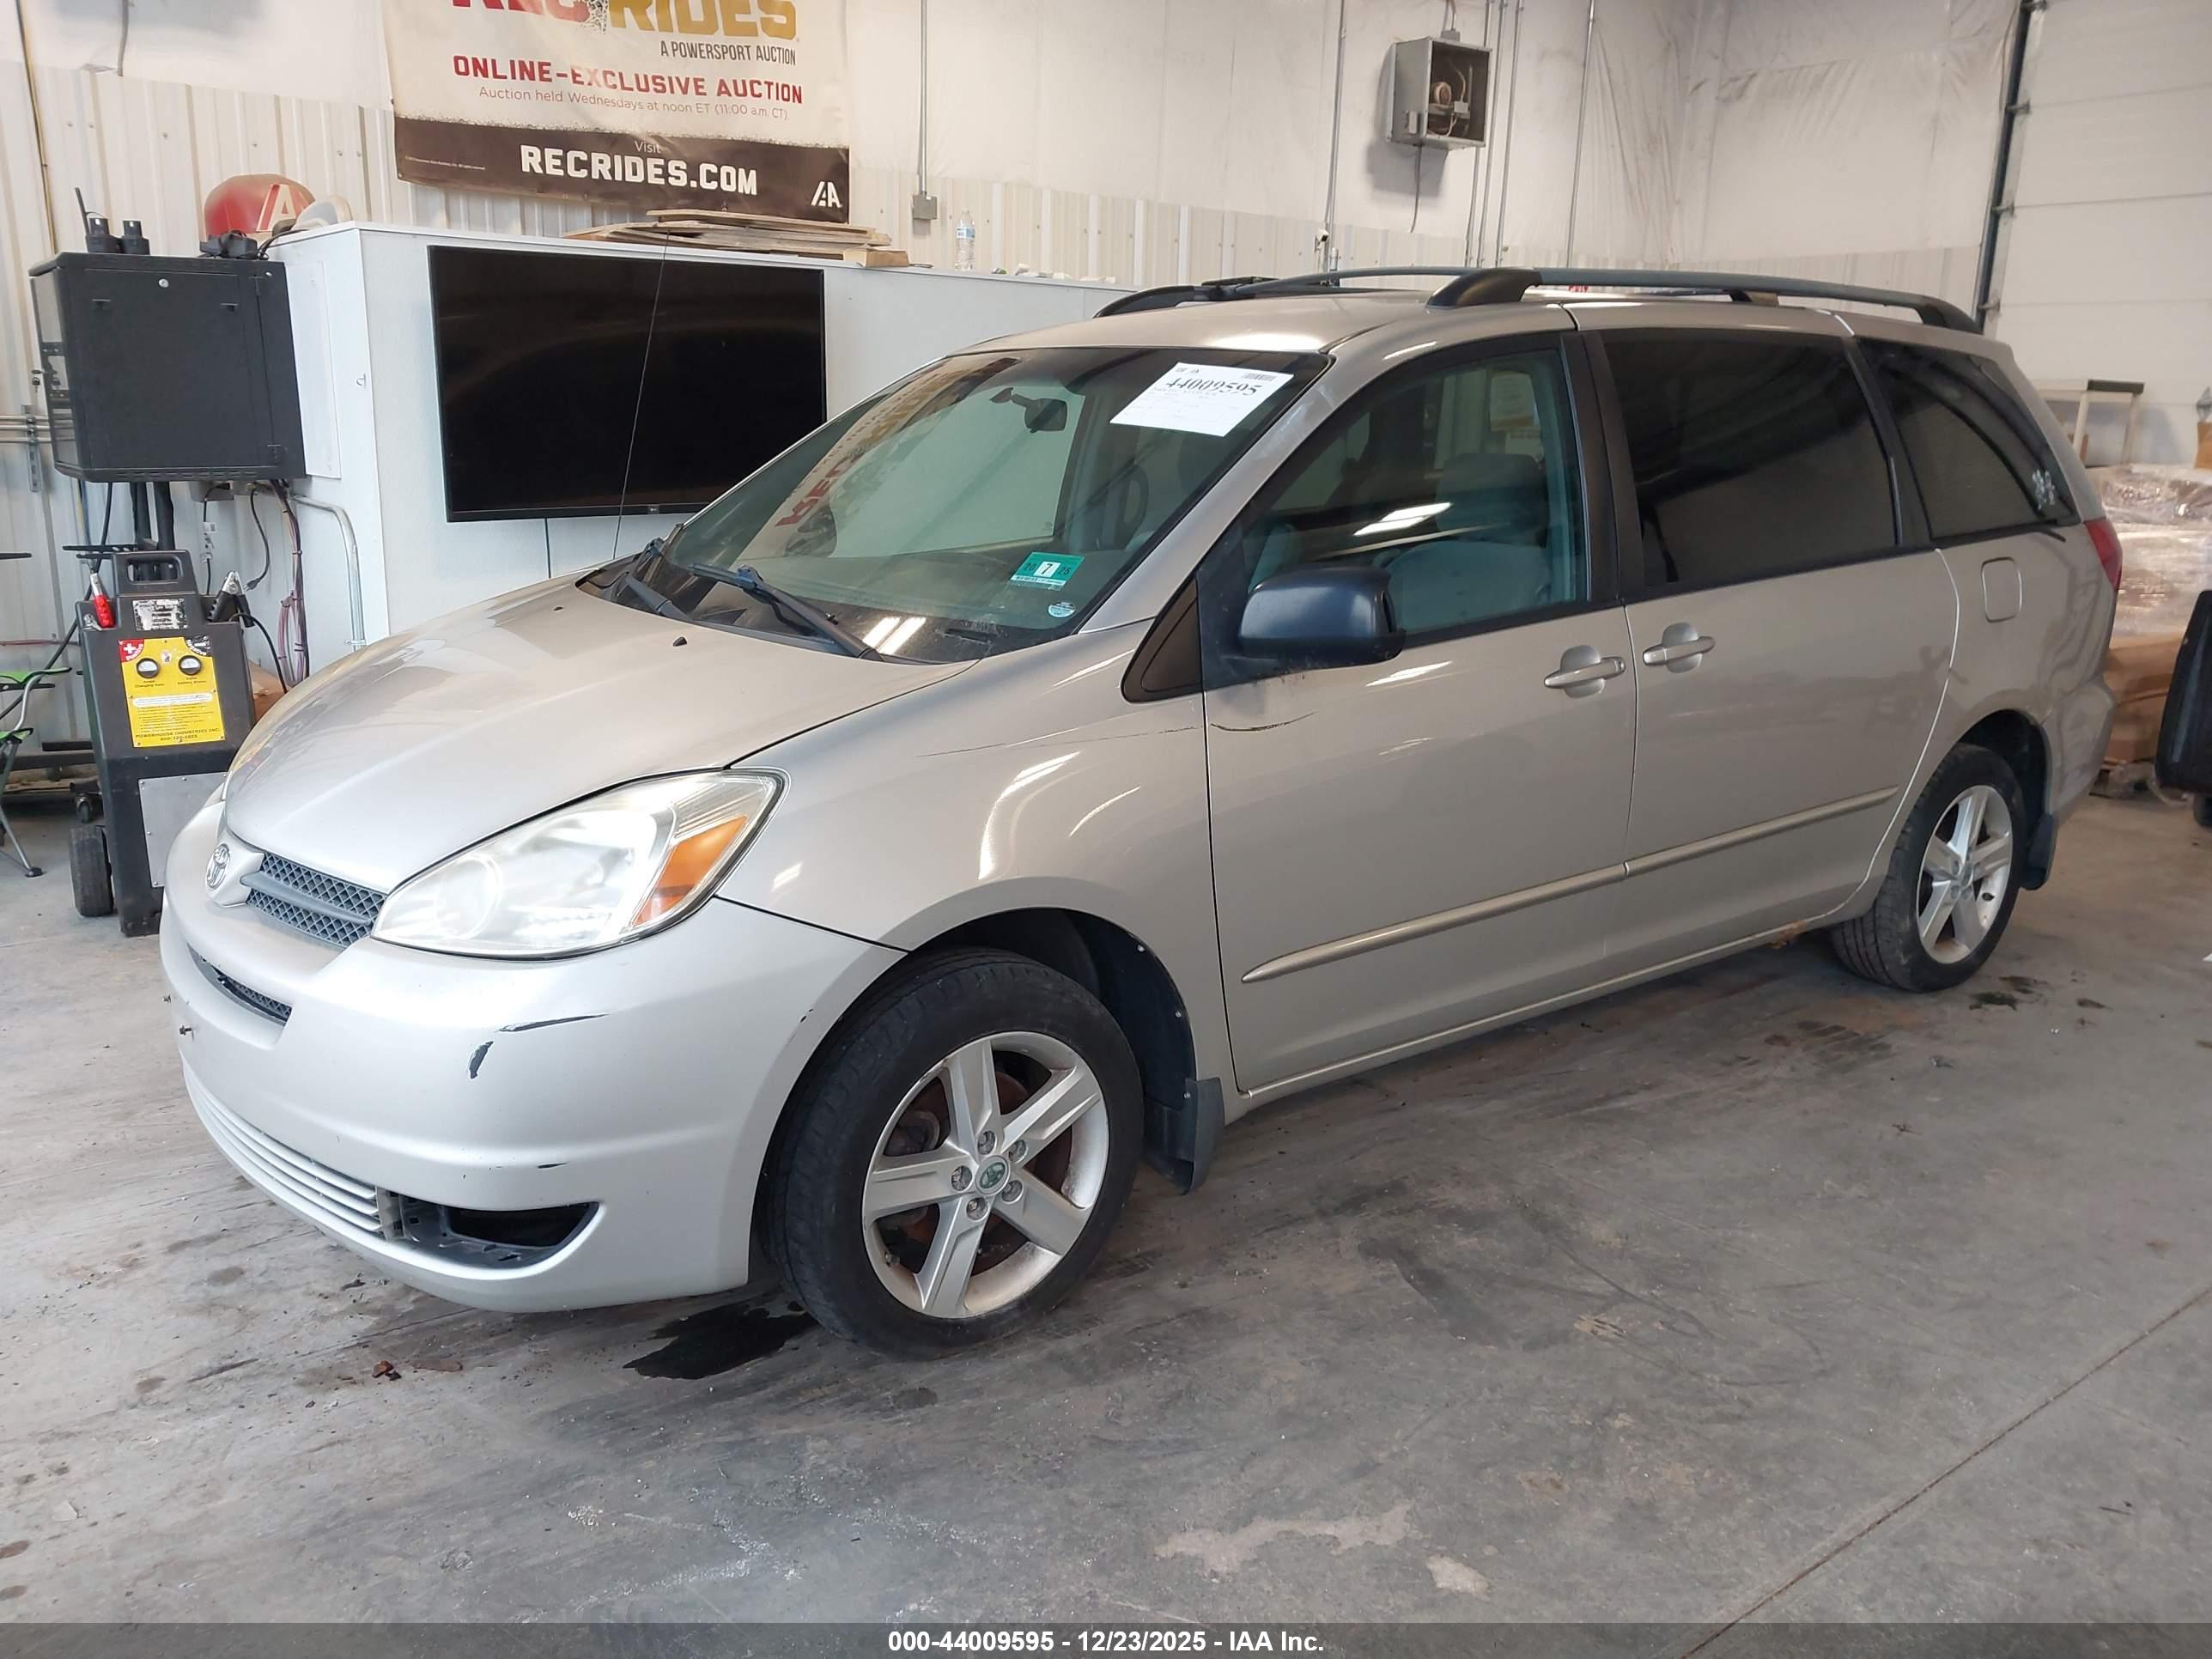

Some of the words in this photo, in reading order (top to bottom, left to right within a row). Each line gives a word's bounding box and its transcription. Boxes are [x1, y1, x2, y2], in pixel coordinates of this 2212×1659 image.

[660, 40, 669, 57] A
[672, 41, 751, 61] POWERSPORT
[756, 45, 796, 66] AUCTION
[453, 55, 708, 96] ONLINE-EXCLUSIVE
[716, 78, 803, 104] AUCTION
[479, 86, 531, 100] Auction
[535, 89, 563, 102] held
[568, 92, 643, 111] Wednesdays
[646, 102, 659, 112] at
[662, 104, 692, 113] noon
[696, 103, 710, 114] ET
[714, 104, 748, 116] (11:00
[635, 140, 661, 155] Visit
[520, 144, 757, 196] RECRIDES.COM
[1165, 377, 1264, 396] 44009595
[1041, 562, 1054, 575] 7
